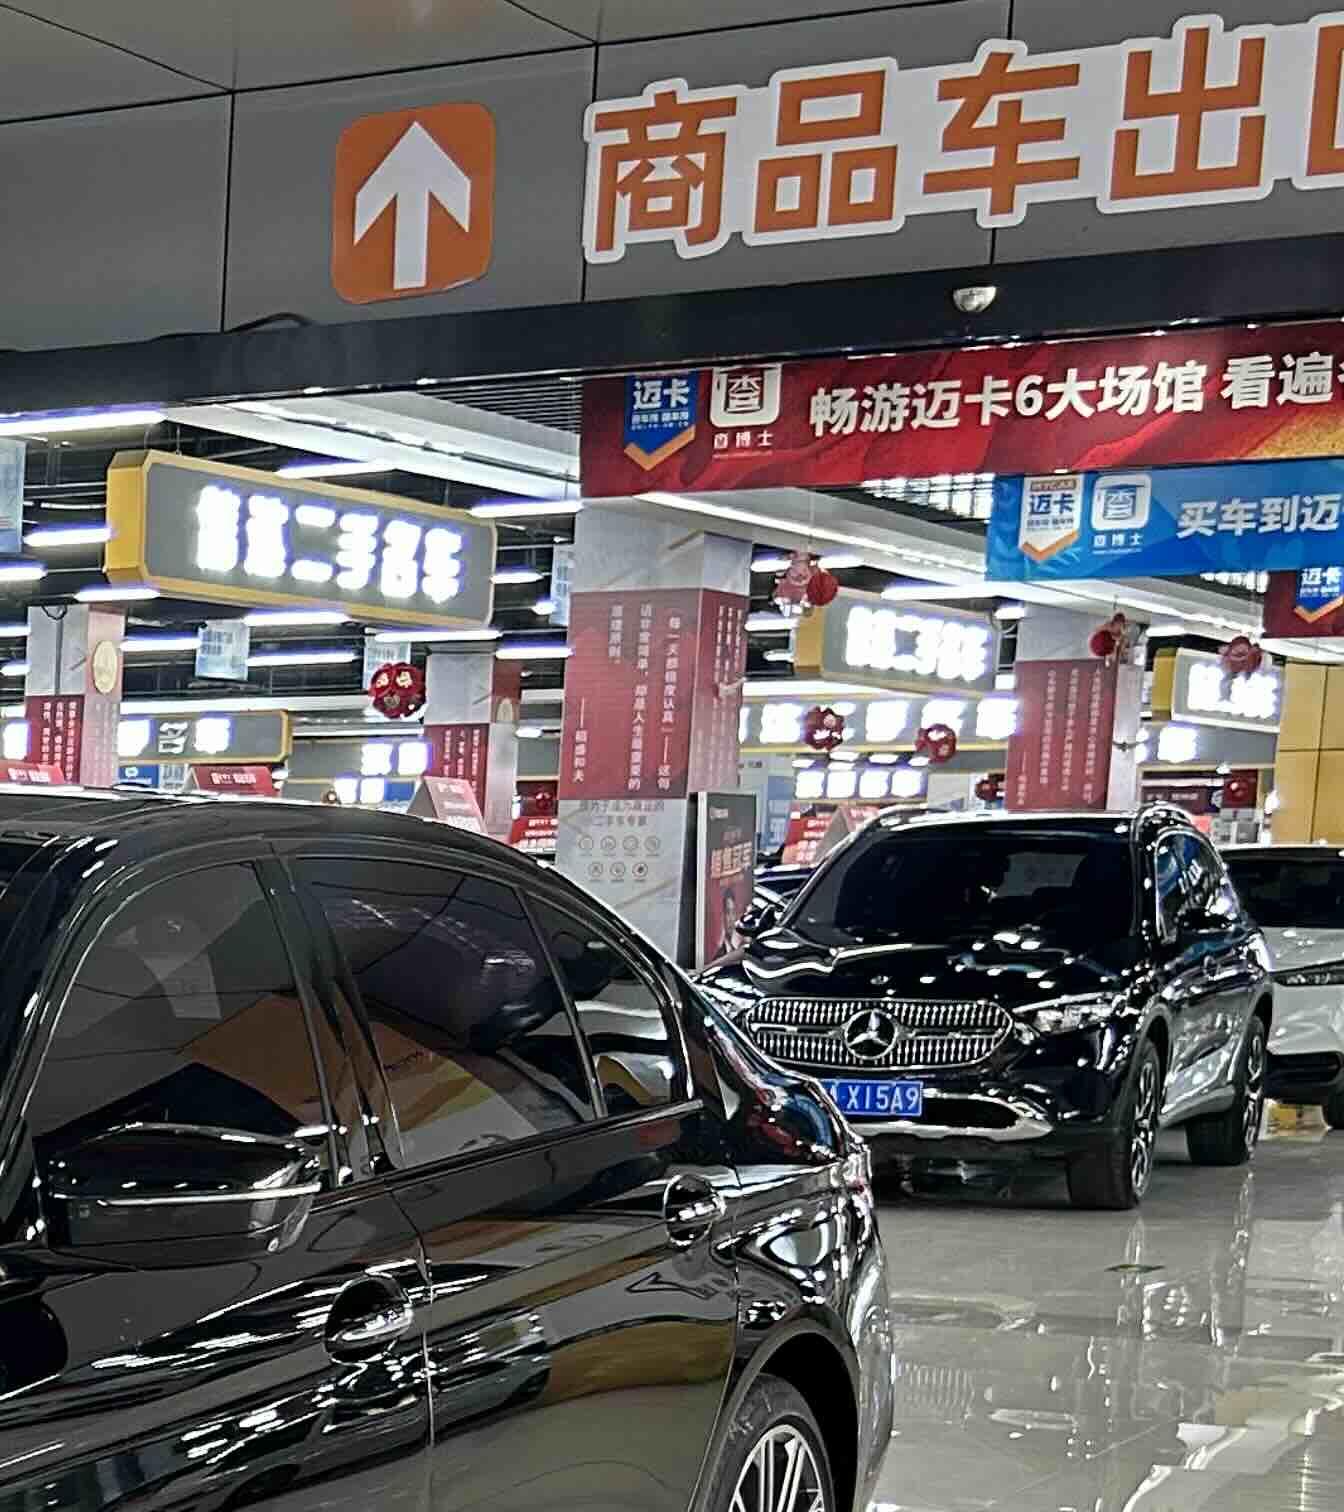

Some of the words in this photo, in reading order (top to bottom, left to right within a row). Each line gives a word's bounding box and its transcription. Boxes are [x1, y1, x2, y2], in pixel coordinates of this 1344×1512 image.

[633, 378, 690, 409] 迈卡
[809, 361, 1207, 436] 畅游迈卡6大场馆
[1220, 352, 1343, 408] 看遍
[1029, 493, 1075, 515] 迈卡
[1176, 493, 1343, 538] 买车到迈
[834, 1084, 919, 1111] X15A9
